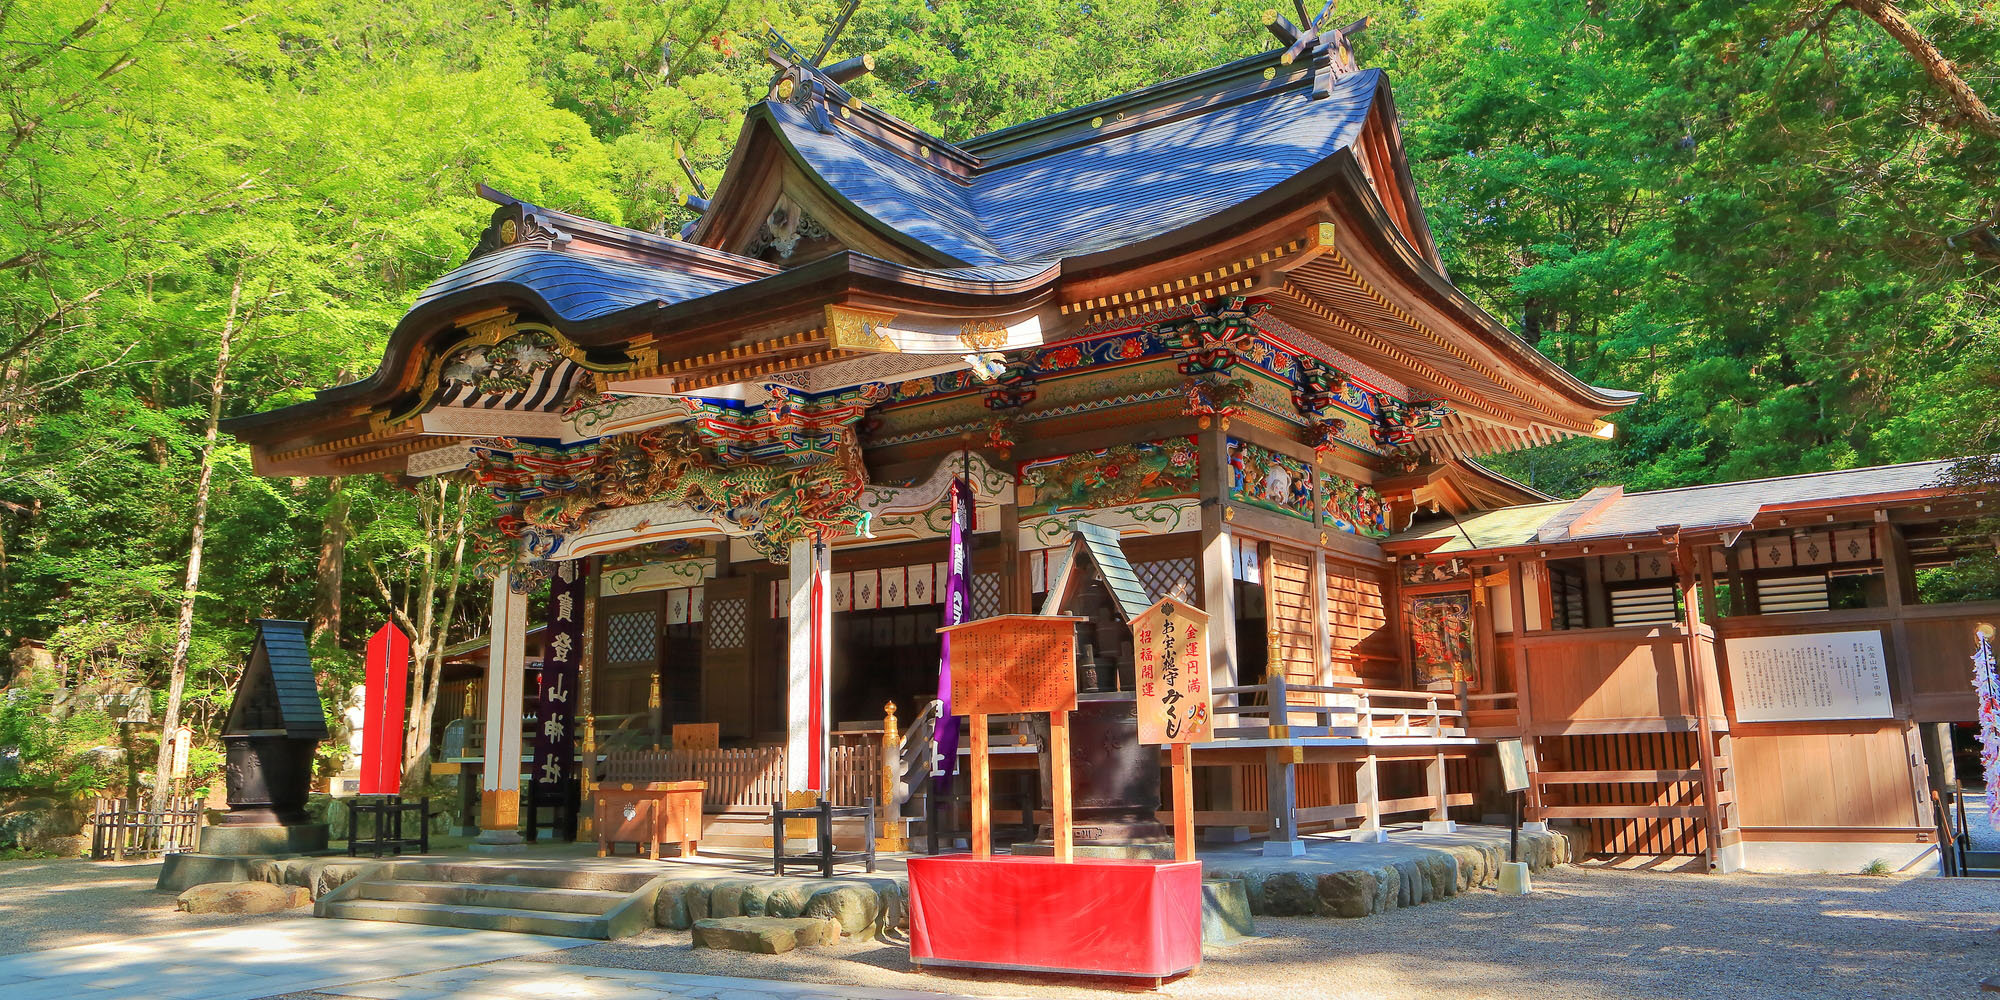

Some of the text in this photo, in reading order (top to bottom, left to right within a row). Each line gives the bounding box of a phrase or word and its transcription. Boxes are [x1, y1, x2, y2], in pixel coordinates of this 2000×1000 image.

[1140, 630, 1155, 697] 招福開運
[1185, 624, 1200, 693] 金運円満
